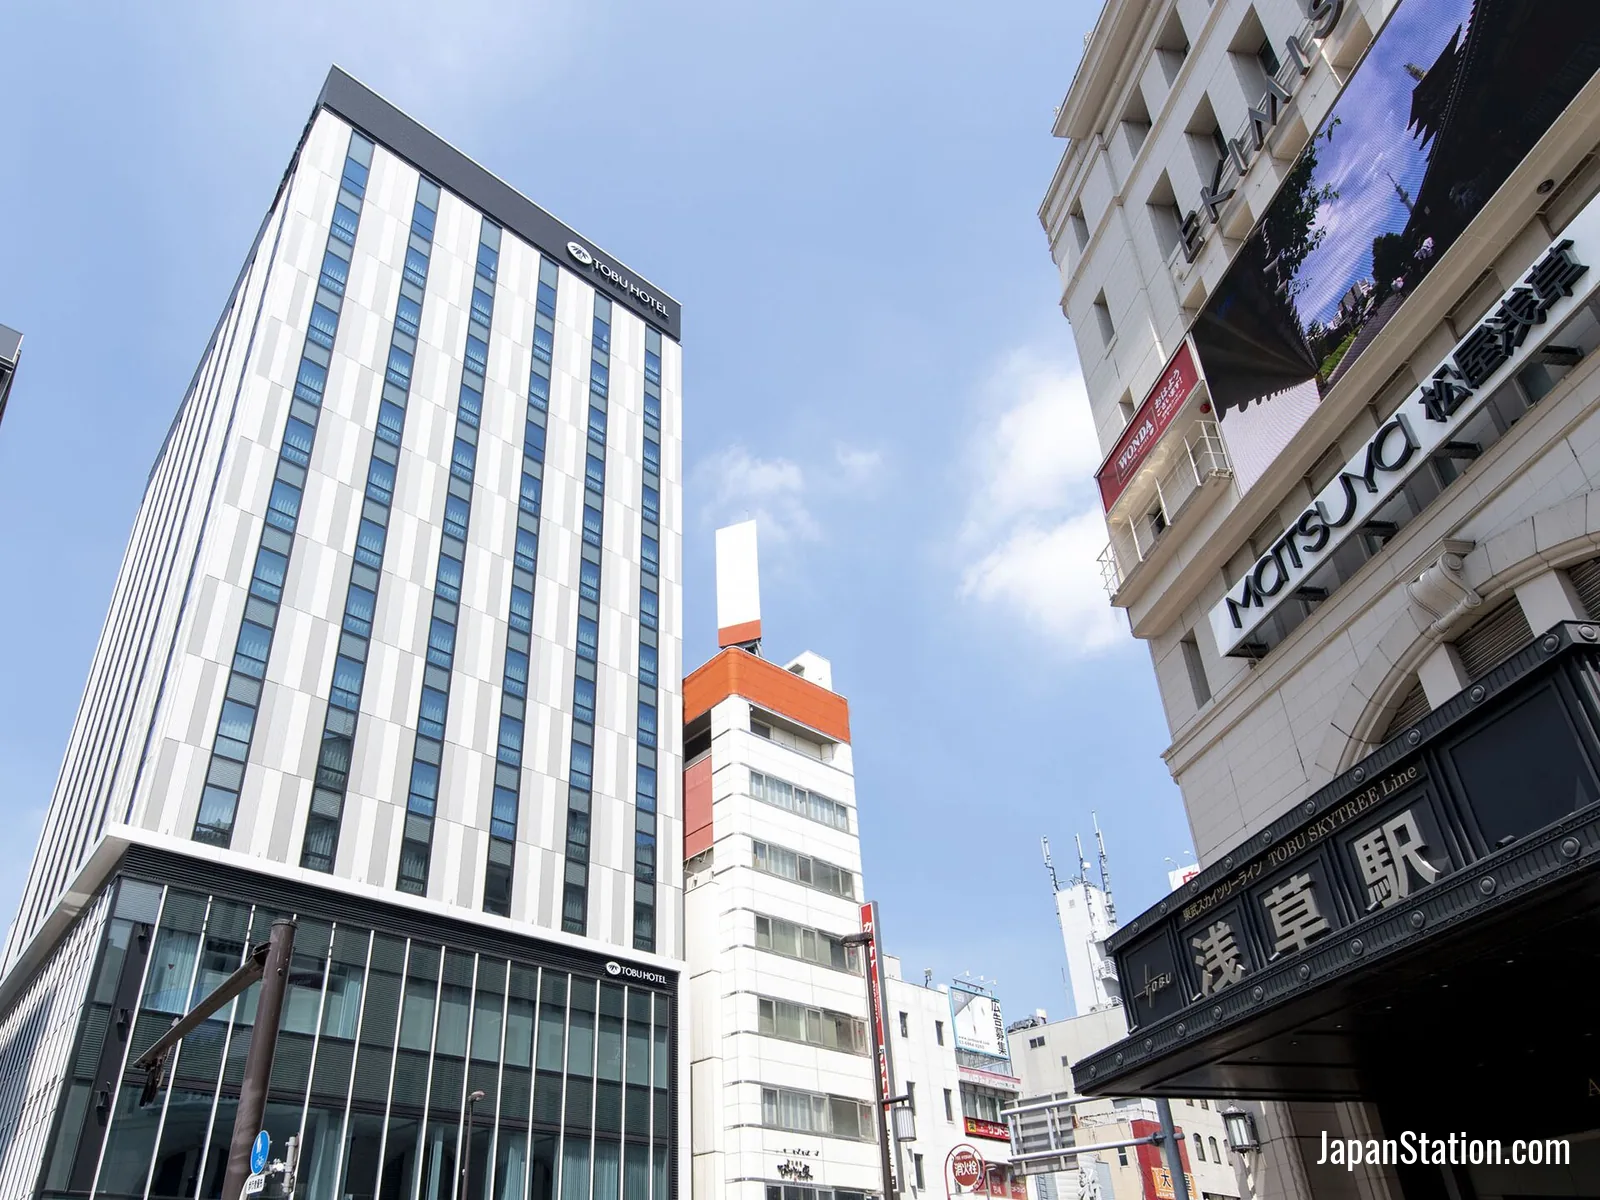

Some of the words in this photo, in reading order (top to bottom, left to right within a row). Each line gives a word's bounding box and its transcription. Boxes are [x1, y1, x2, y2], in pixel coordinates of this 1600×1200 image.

[593, 258, 628, 289] TOBU
[630, 283, 669, 318] HOTEL
[1419, 239, 1590, 423] 松屋浅草
[1154, 368, 1180, 410] おはよう
[1118, 419, 1153, 470] WONDA
[1182, 863, 1263, 922] 東武スカイツリーライン
[1267, 833, 1306, 868] TOBU
[1308, 786, 1380, 842] SKYTREE
[1382, 766, 1418, 796] Line
[1192, 809, 1442, 1000] 浅草駅
[621, 966, 642, 979] TOBU
[643, 971, 667, 985] HOTEL
